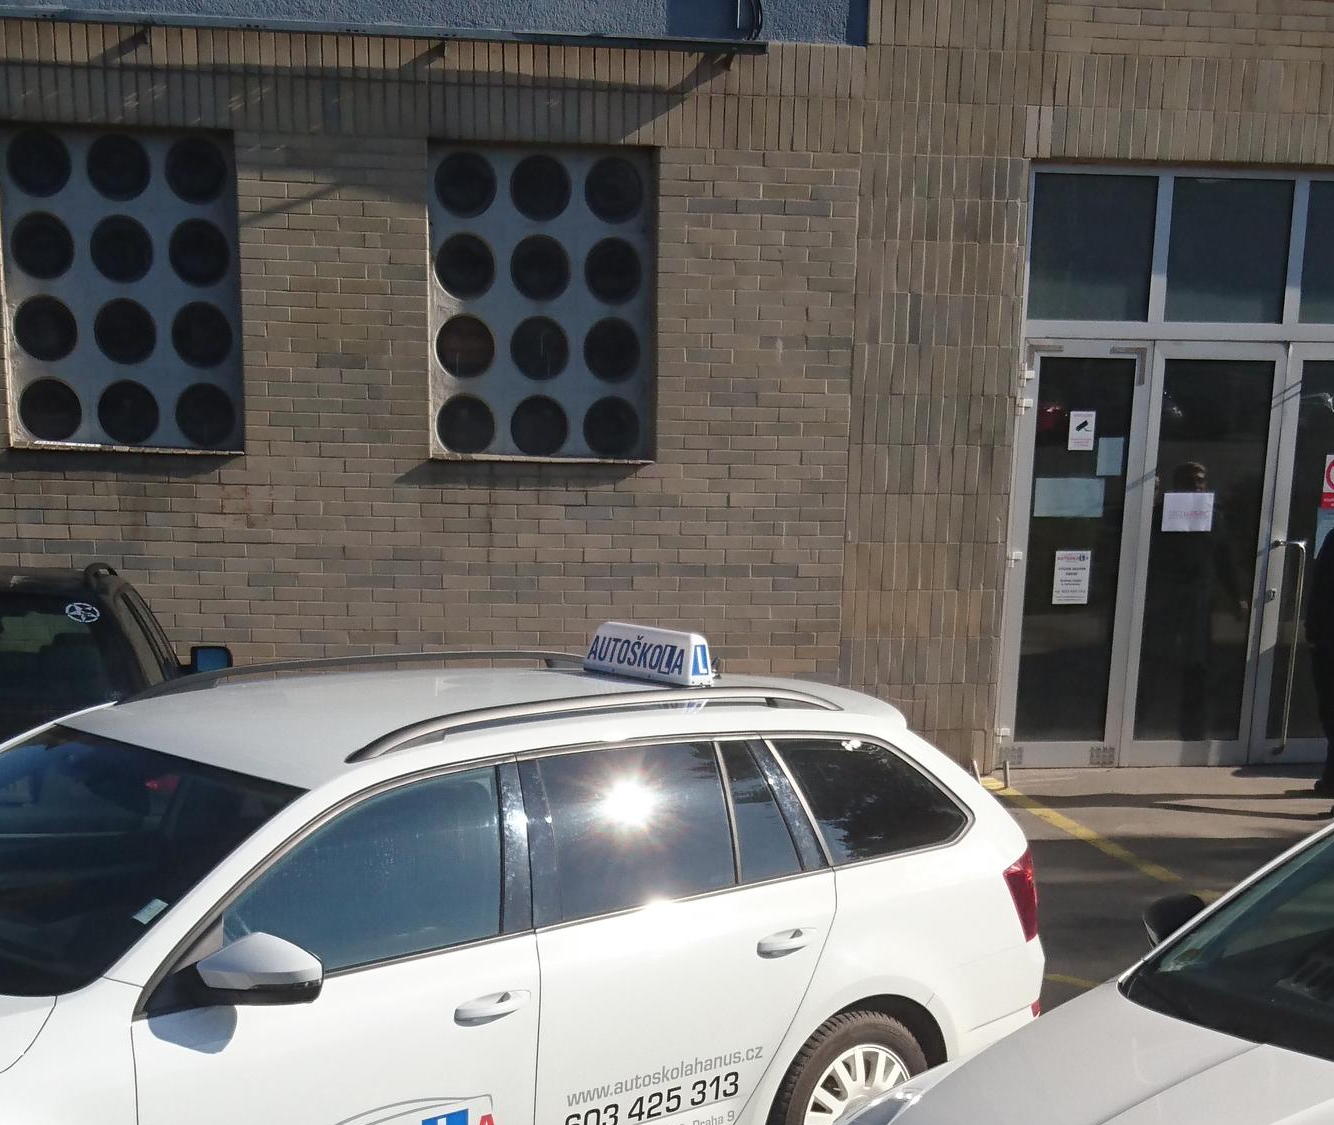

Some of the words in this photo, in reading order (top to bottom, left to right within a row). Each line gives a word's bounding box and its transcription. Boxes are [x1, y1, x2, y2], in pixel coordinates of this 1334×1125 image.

[587, 635, 685, 675] AUTOŠKOLA
[567, 1046, 763, 1107] www.autoskolahanus.cz
[628, 1086, 682, 1121] 425
[690, 1071, 739, 1106] 313
[727, 1110, 735, 1122] 9
